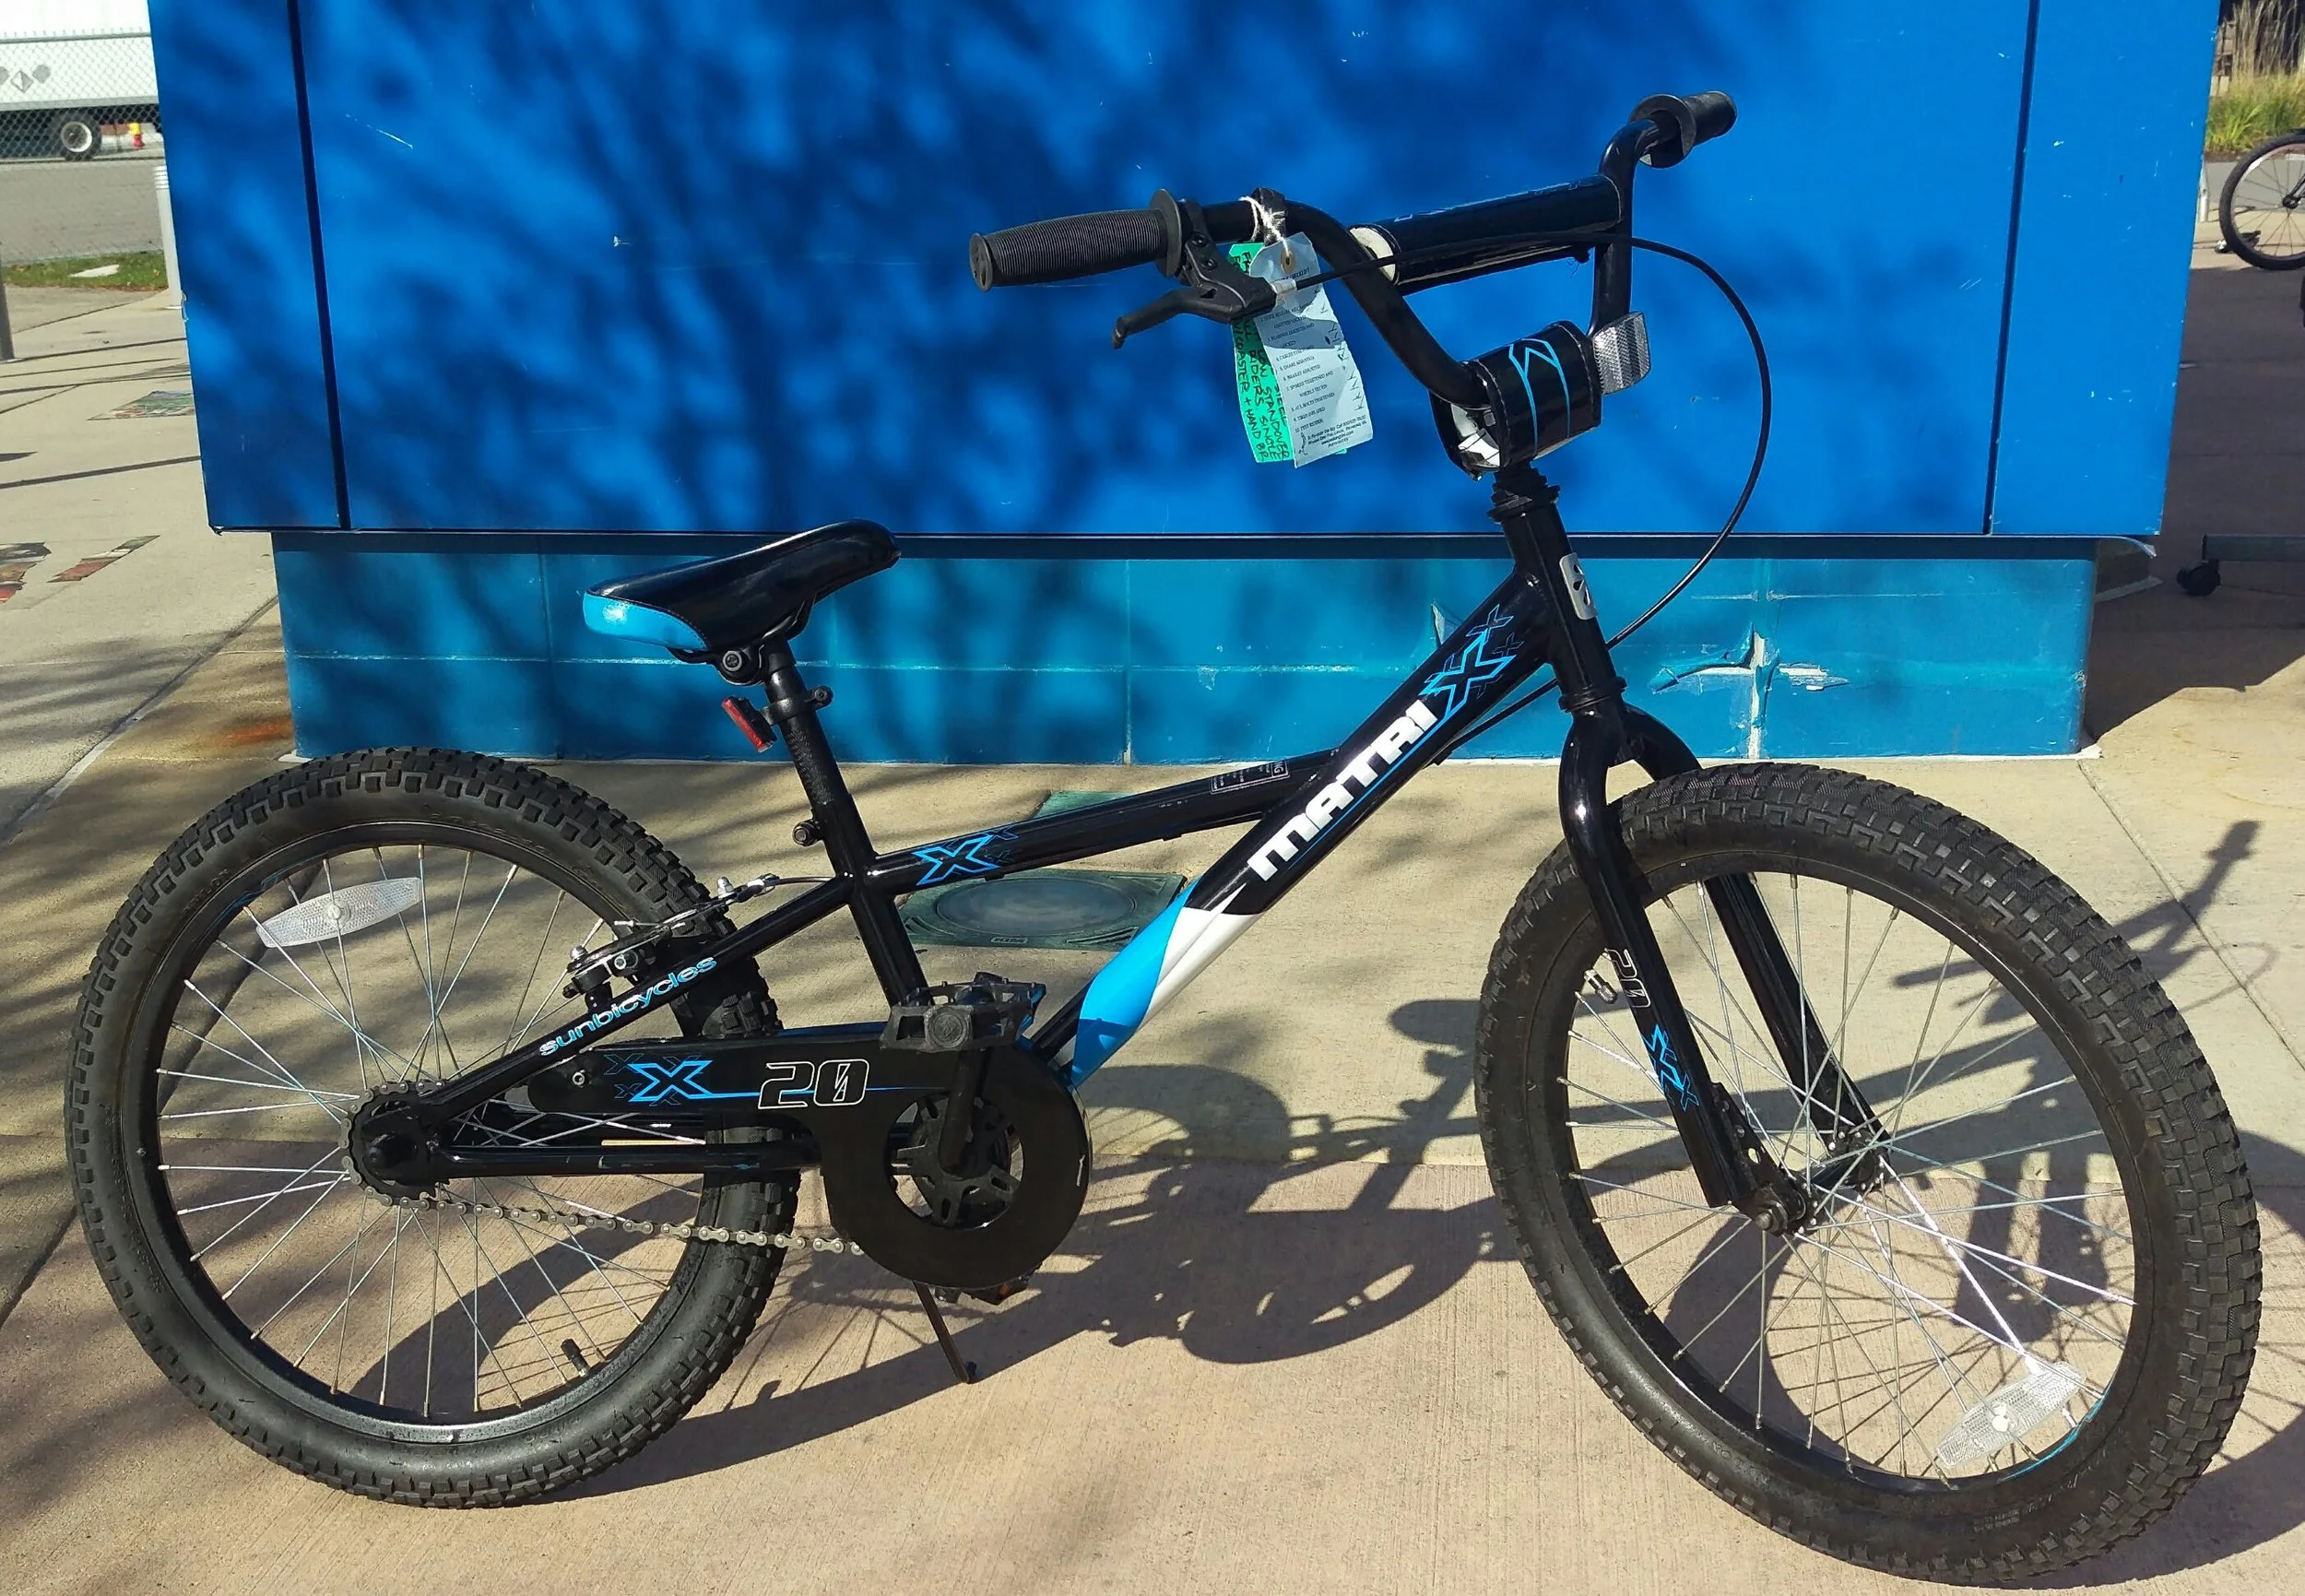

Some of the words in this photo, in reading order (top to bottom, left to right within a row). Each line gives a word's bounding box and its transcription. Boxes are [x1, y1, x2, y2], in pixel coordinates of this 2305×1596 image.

[1246, 408, 1262, 440] HAND
[1259, 415, 1278, 459] SINGLE
[1262, 385, 1290, 459] STANDOVER
[539, 956, 717, 1057] sunbicycles
[758, 1058, 869, 1110] 20
